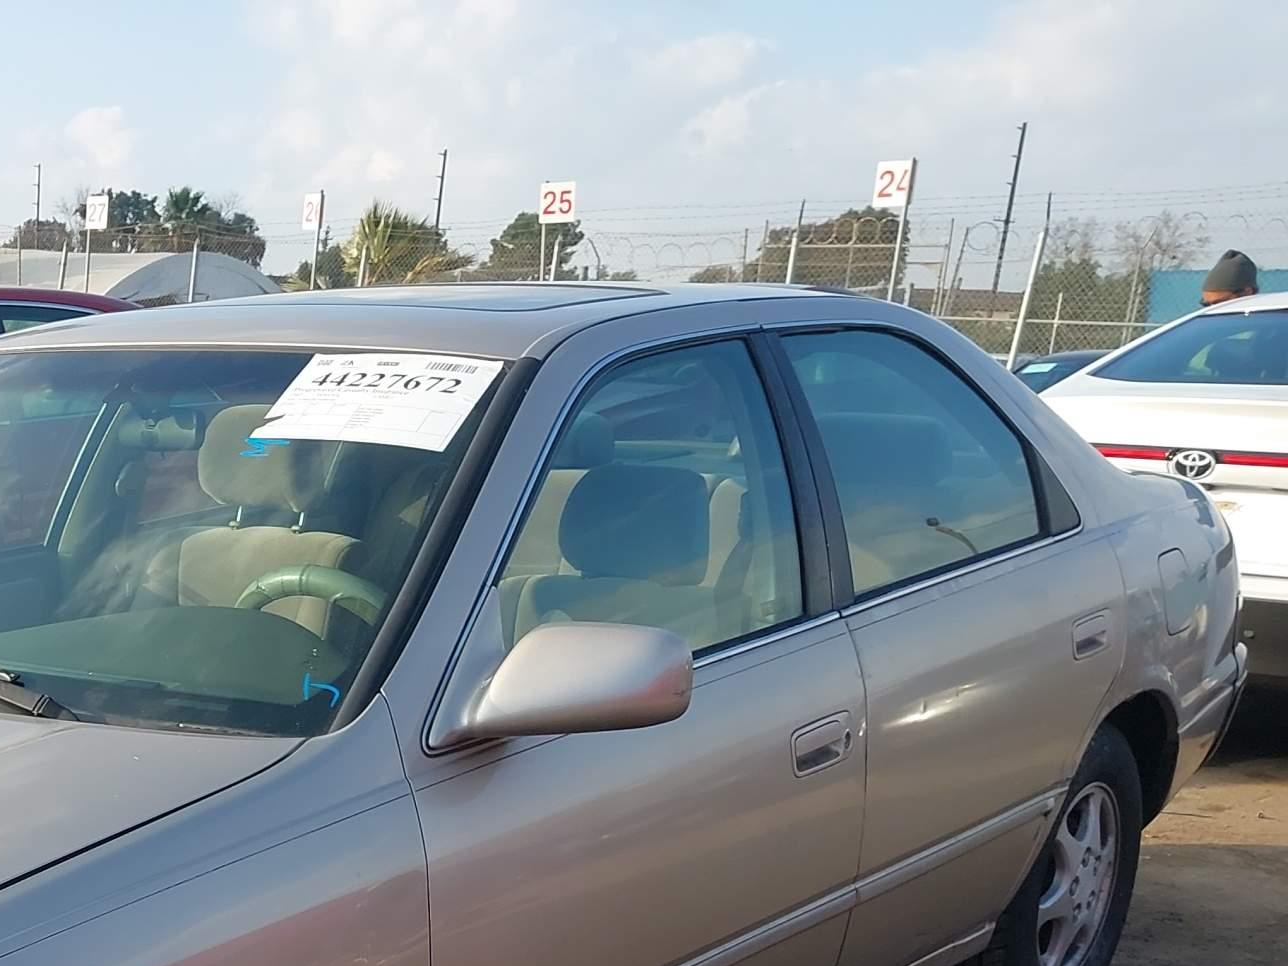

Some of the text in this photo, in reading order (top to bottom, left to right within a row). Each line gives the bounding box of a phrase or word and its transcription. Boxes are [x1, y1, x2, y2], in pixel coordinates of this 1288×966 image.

[88, 203, 105, 222] 27
[542, 190, 572, 214] 25
[311, 372, 462, 394] 44227672
